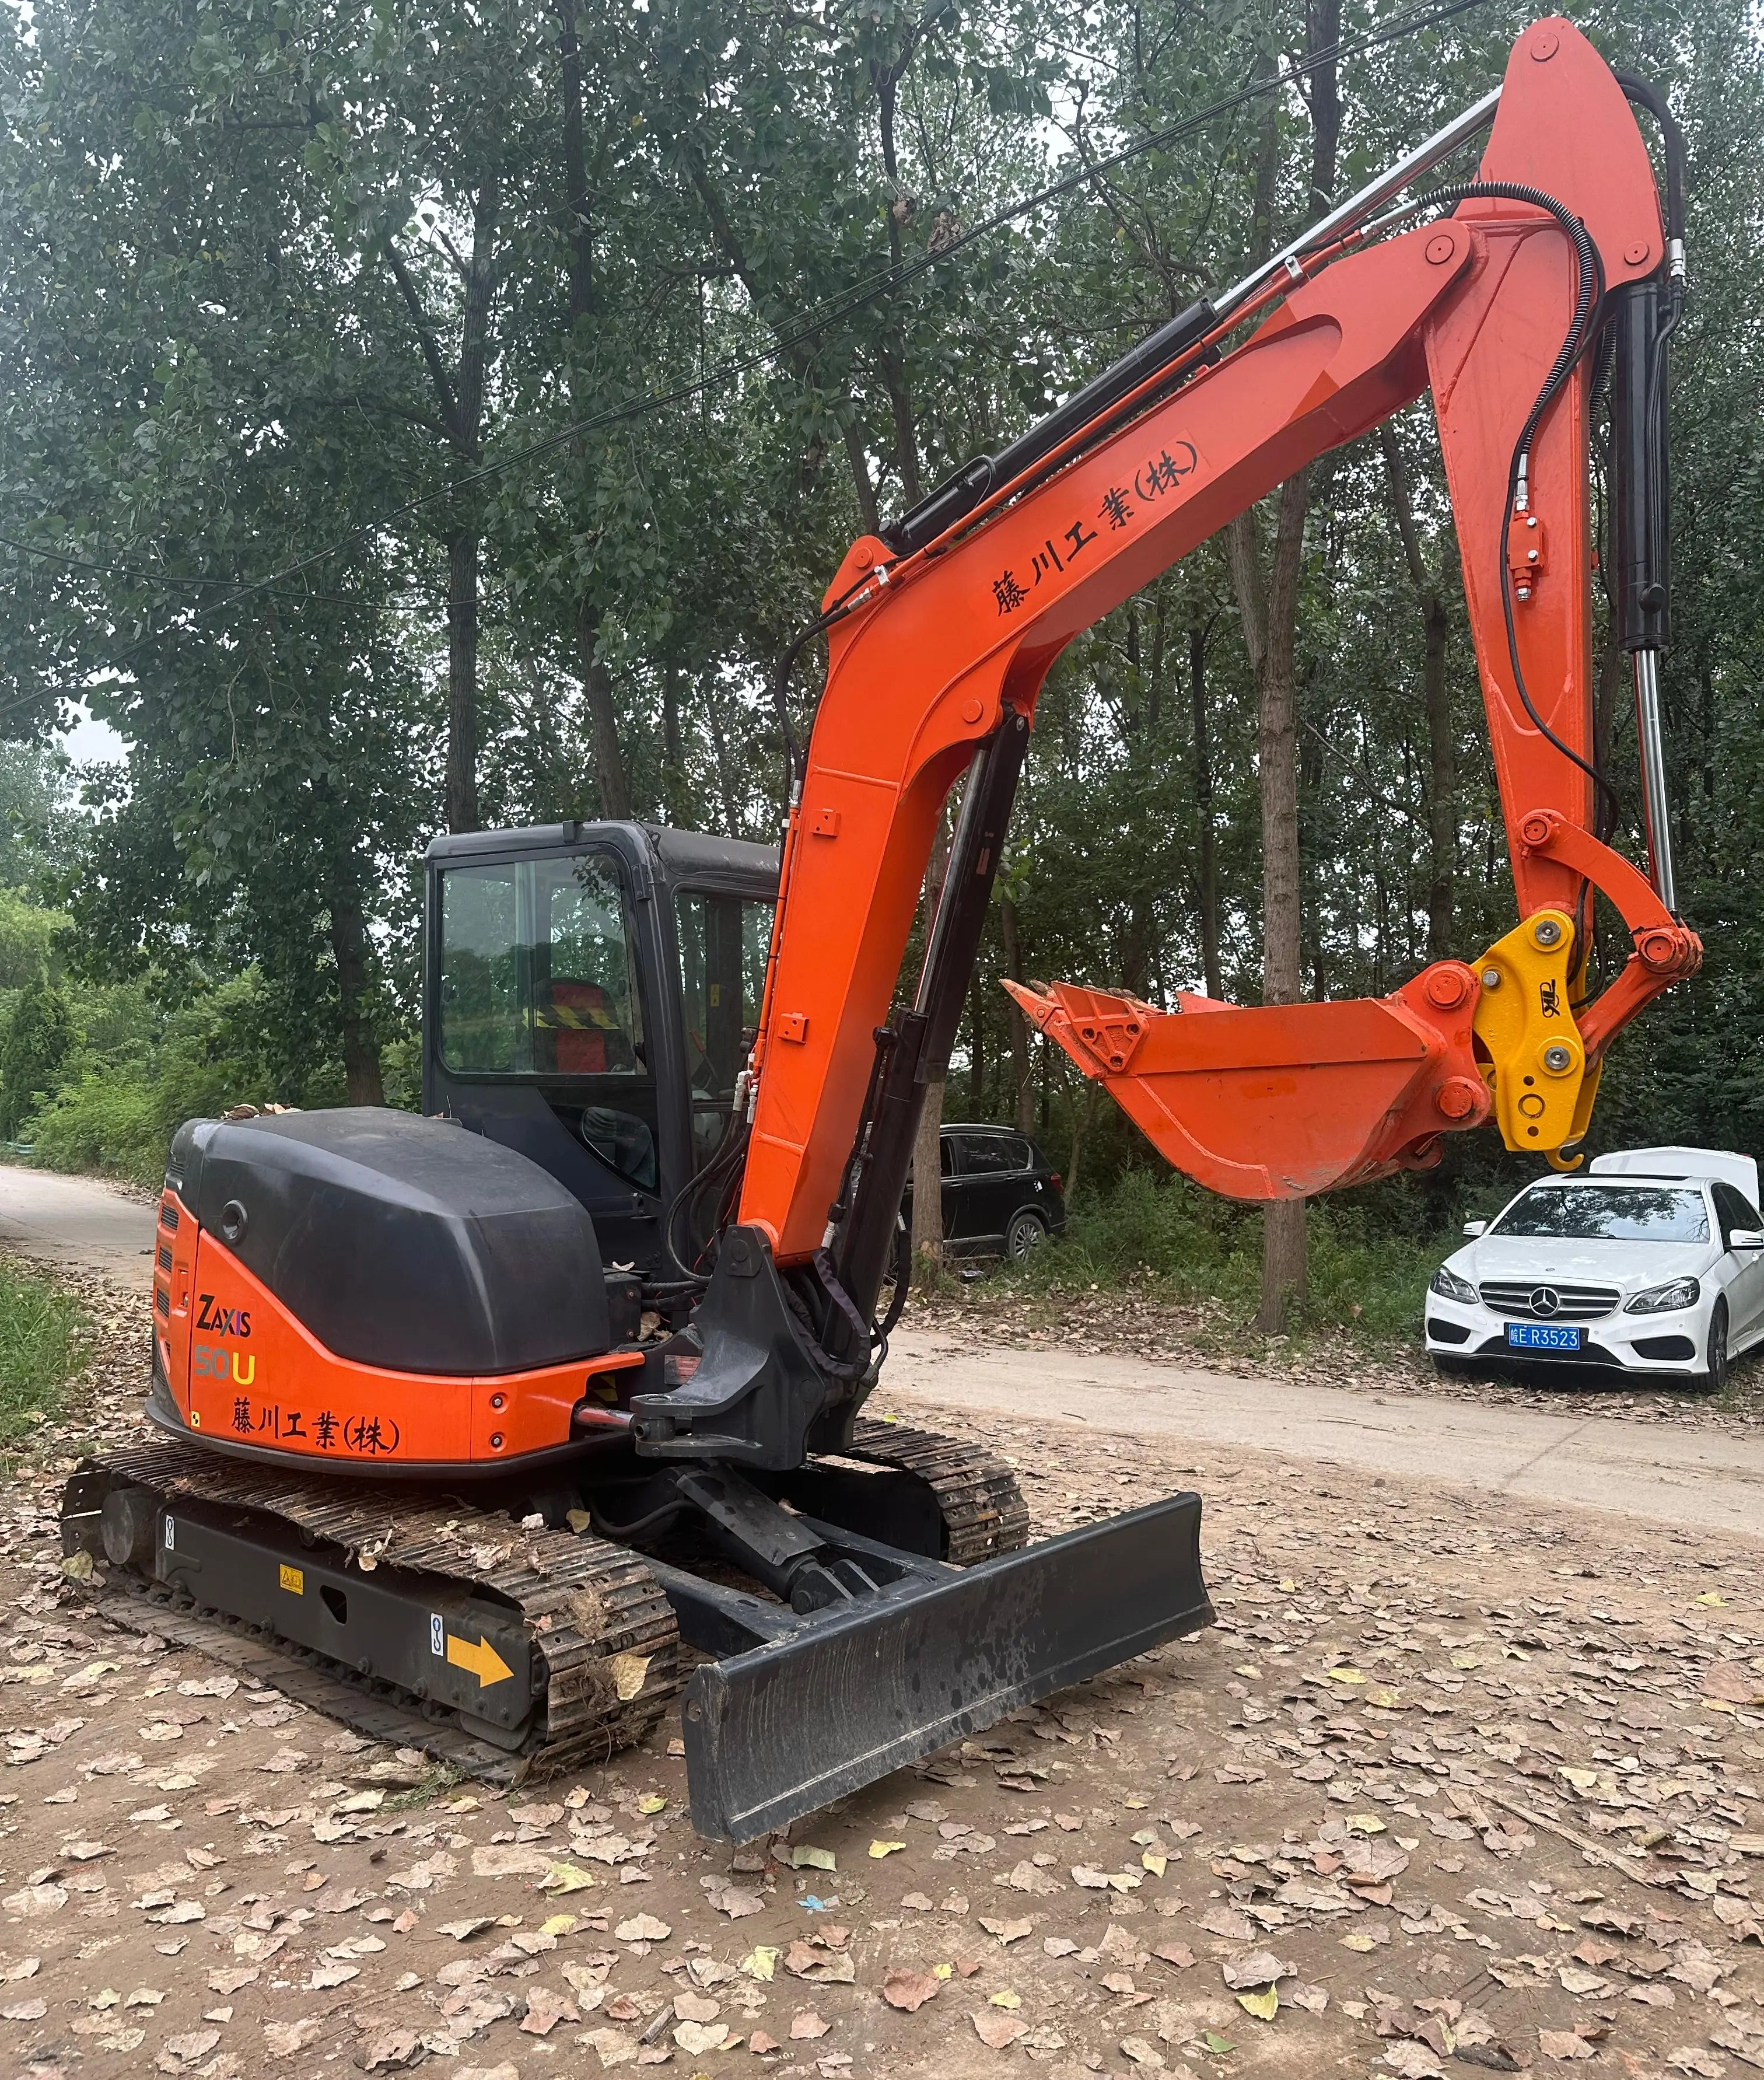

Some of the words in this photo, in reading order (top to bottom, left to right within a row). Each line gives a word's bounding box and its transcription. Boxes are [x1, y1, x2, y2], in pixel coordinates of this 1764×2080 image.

[992, 441, 1198, 617] 藤川工業(株)
[196, 1294, 251, 1338] ZAXIS
[231, 1396, 400, 1455] 藤川工業(株)
